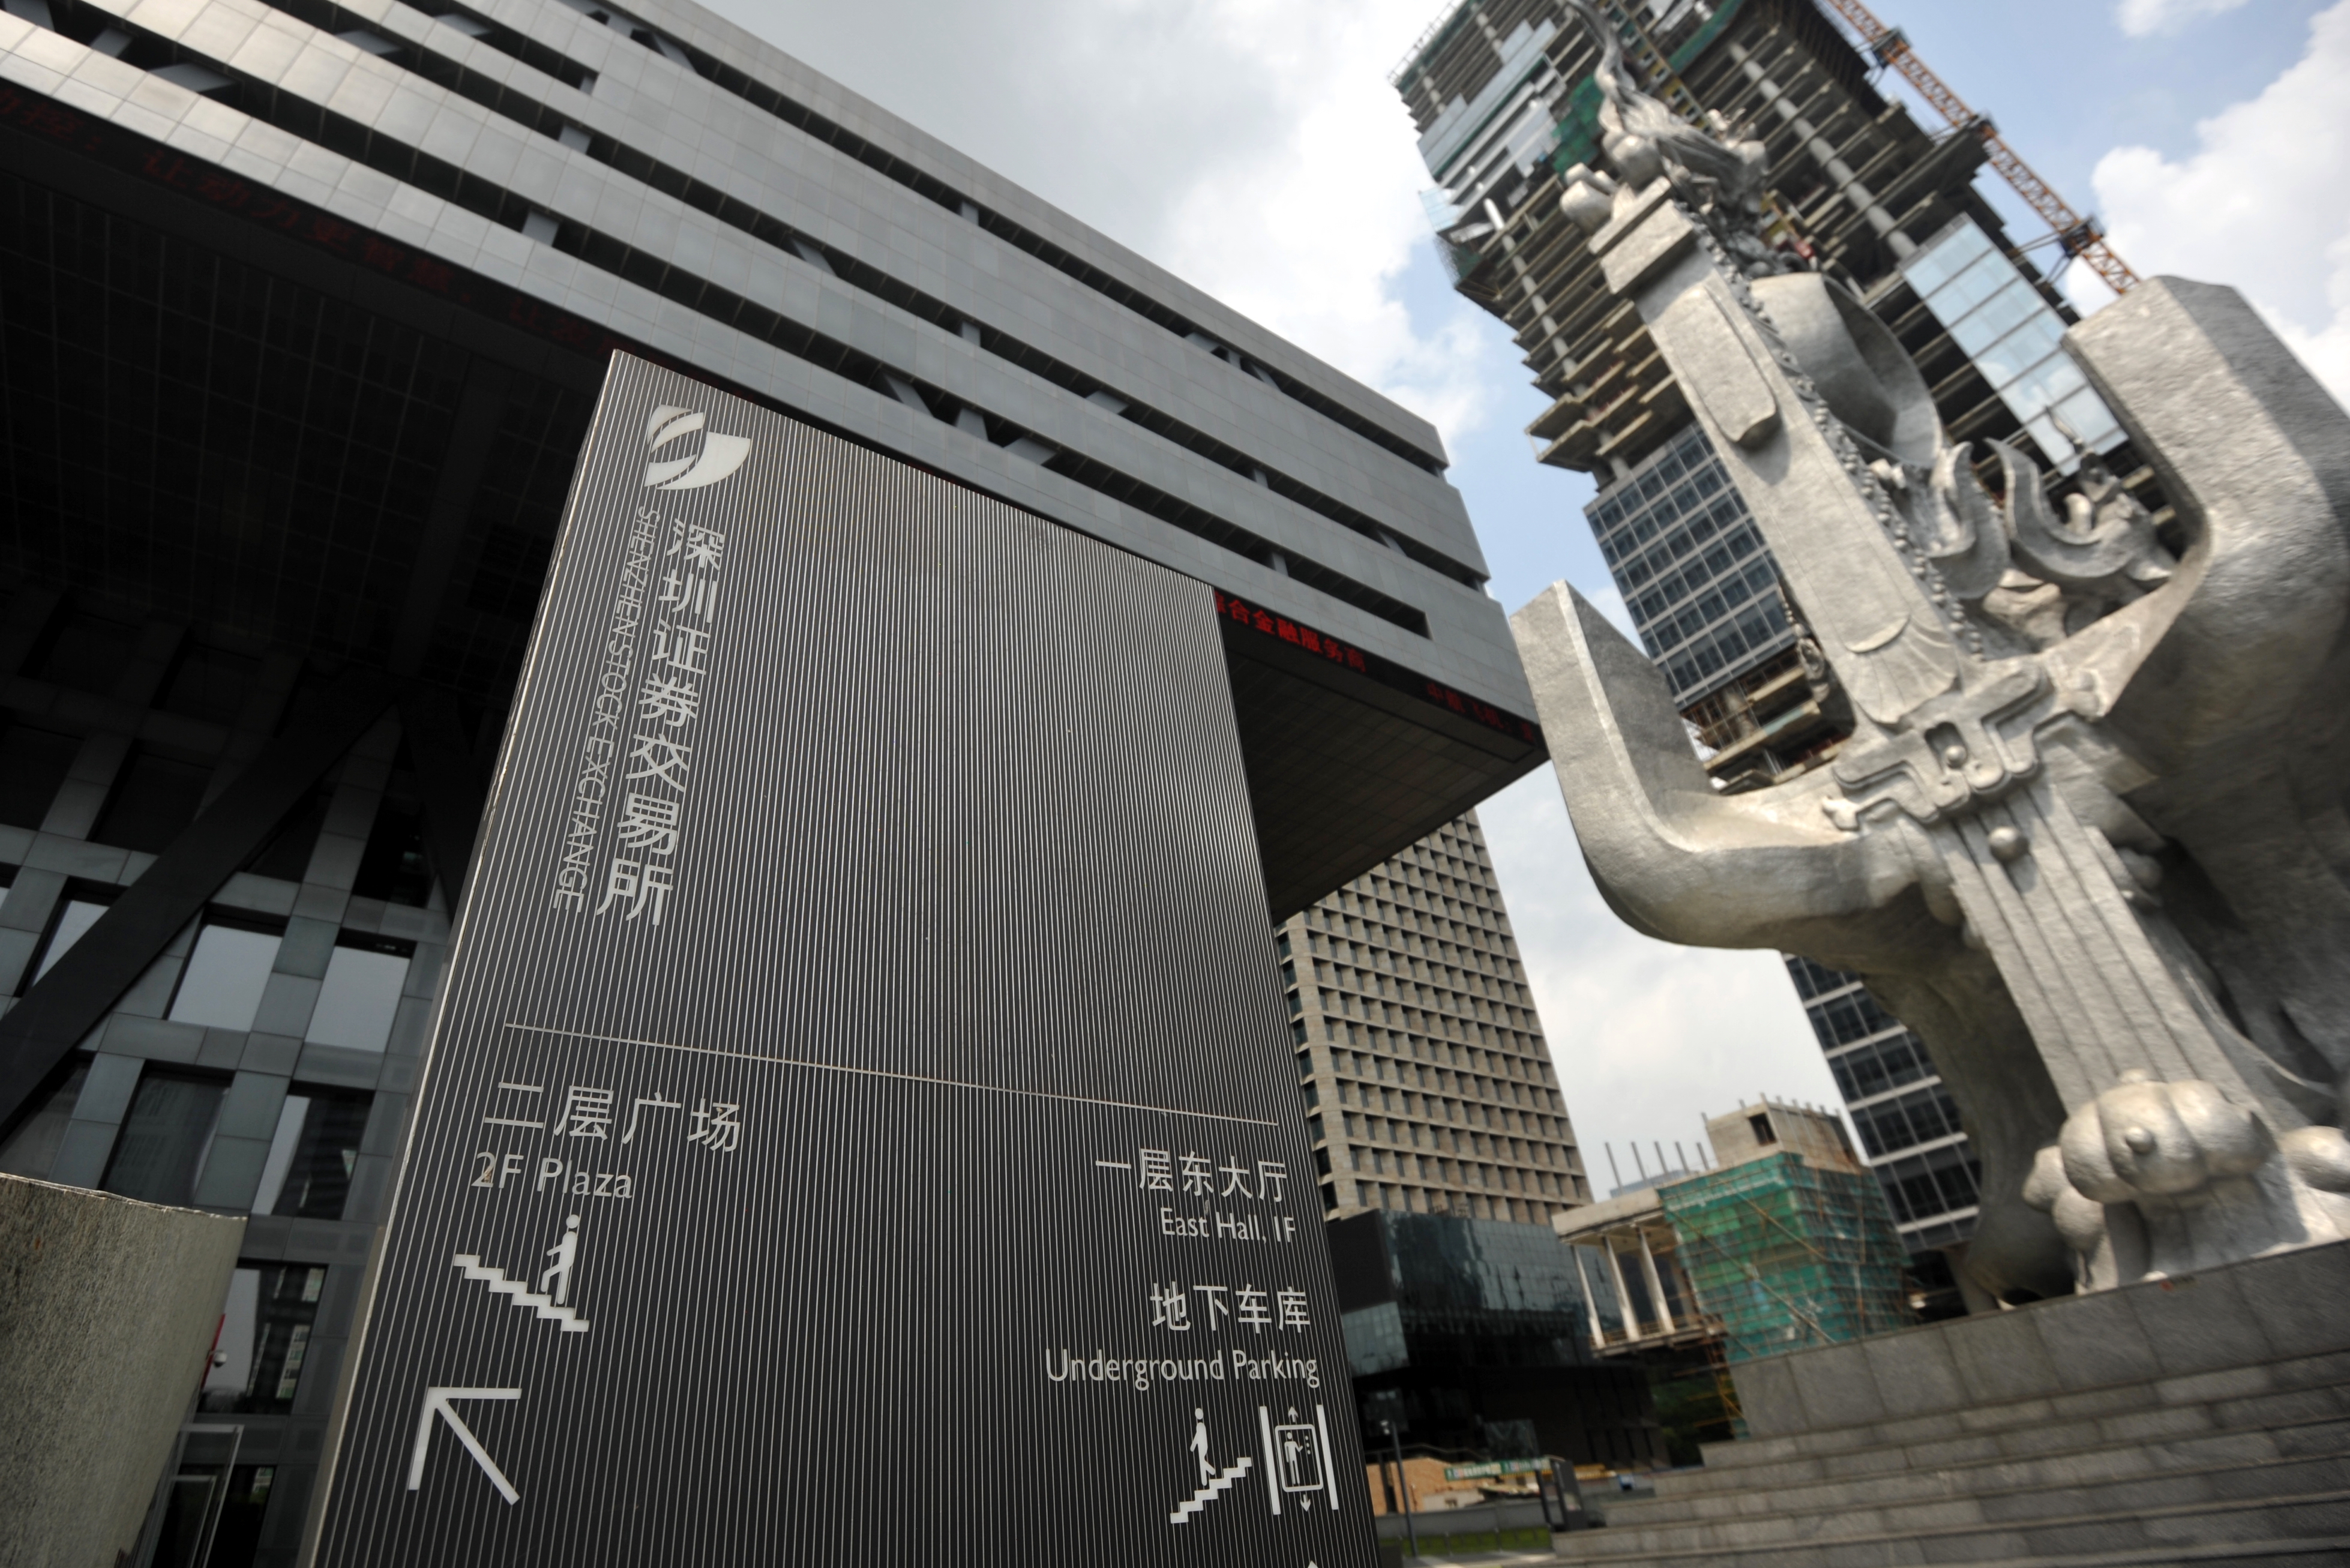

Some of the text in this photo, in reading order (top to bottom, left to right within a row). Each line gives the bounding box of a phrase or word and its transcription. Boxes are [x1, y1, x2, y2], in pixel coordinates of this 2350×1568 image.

[553, 506, 660, 913] SHENZHEN STOCK EXCHANGE
[597, 518, 725, 926] 深圳证券交易所
[484, 1082, 741, 1152] 二层广场
[471, 1152, 632, 1199] 2F Plaza
[1096, 1149, 1287, 1203] 一层东大厅
[1161, 1207, 1209, 1237] East
[1216, 1212, 1266, 1244] Hall,
[1150, 1281, 1311, 1333] 地下车库
[1046, 1348, 1320, 1391] Underground Parking
